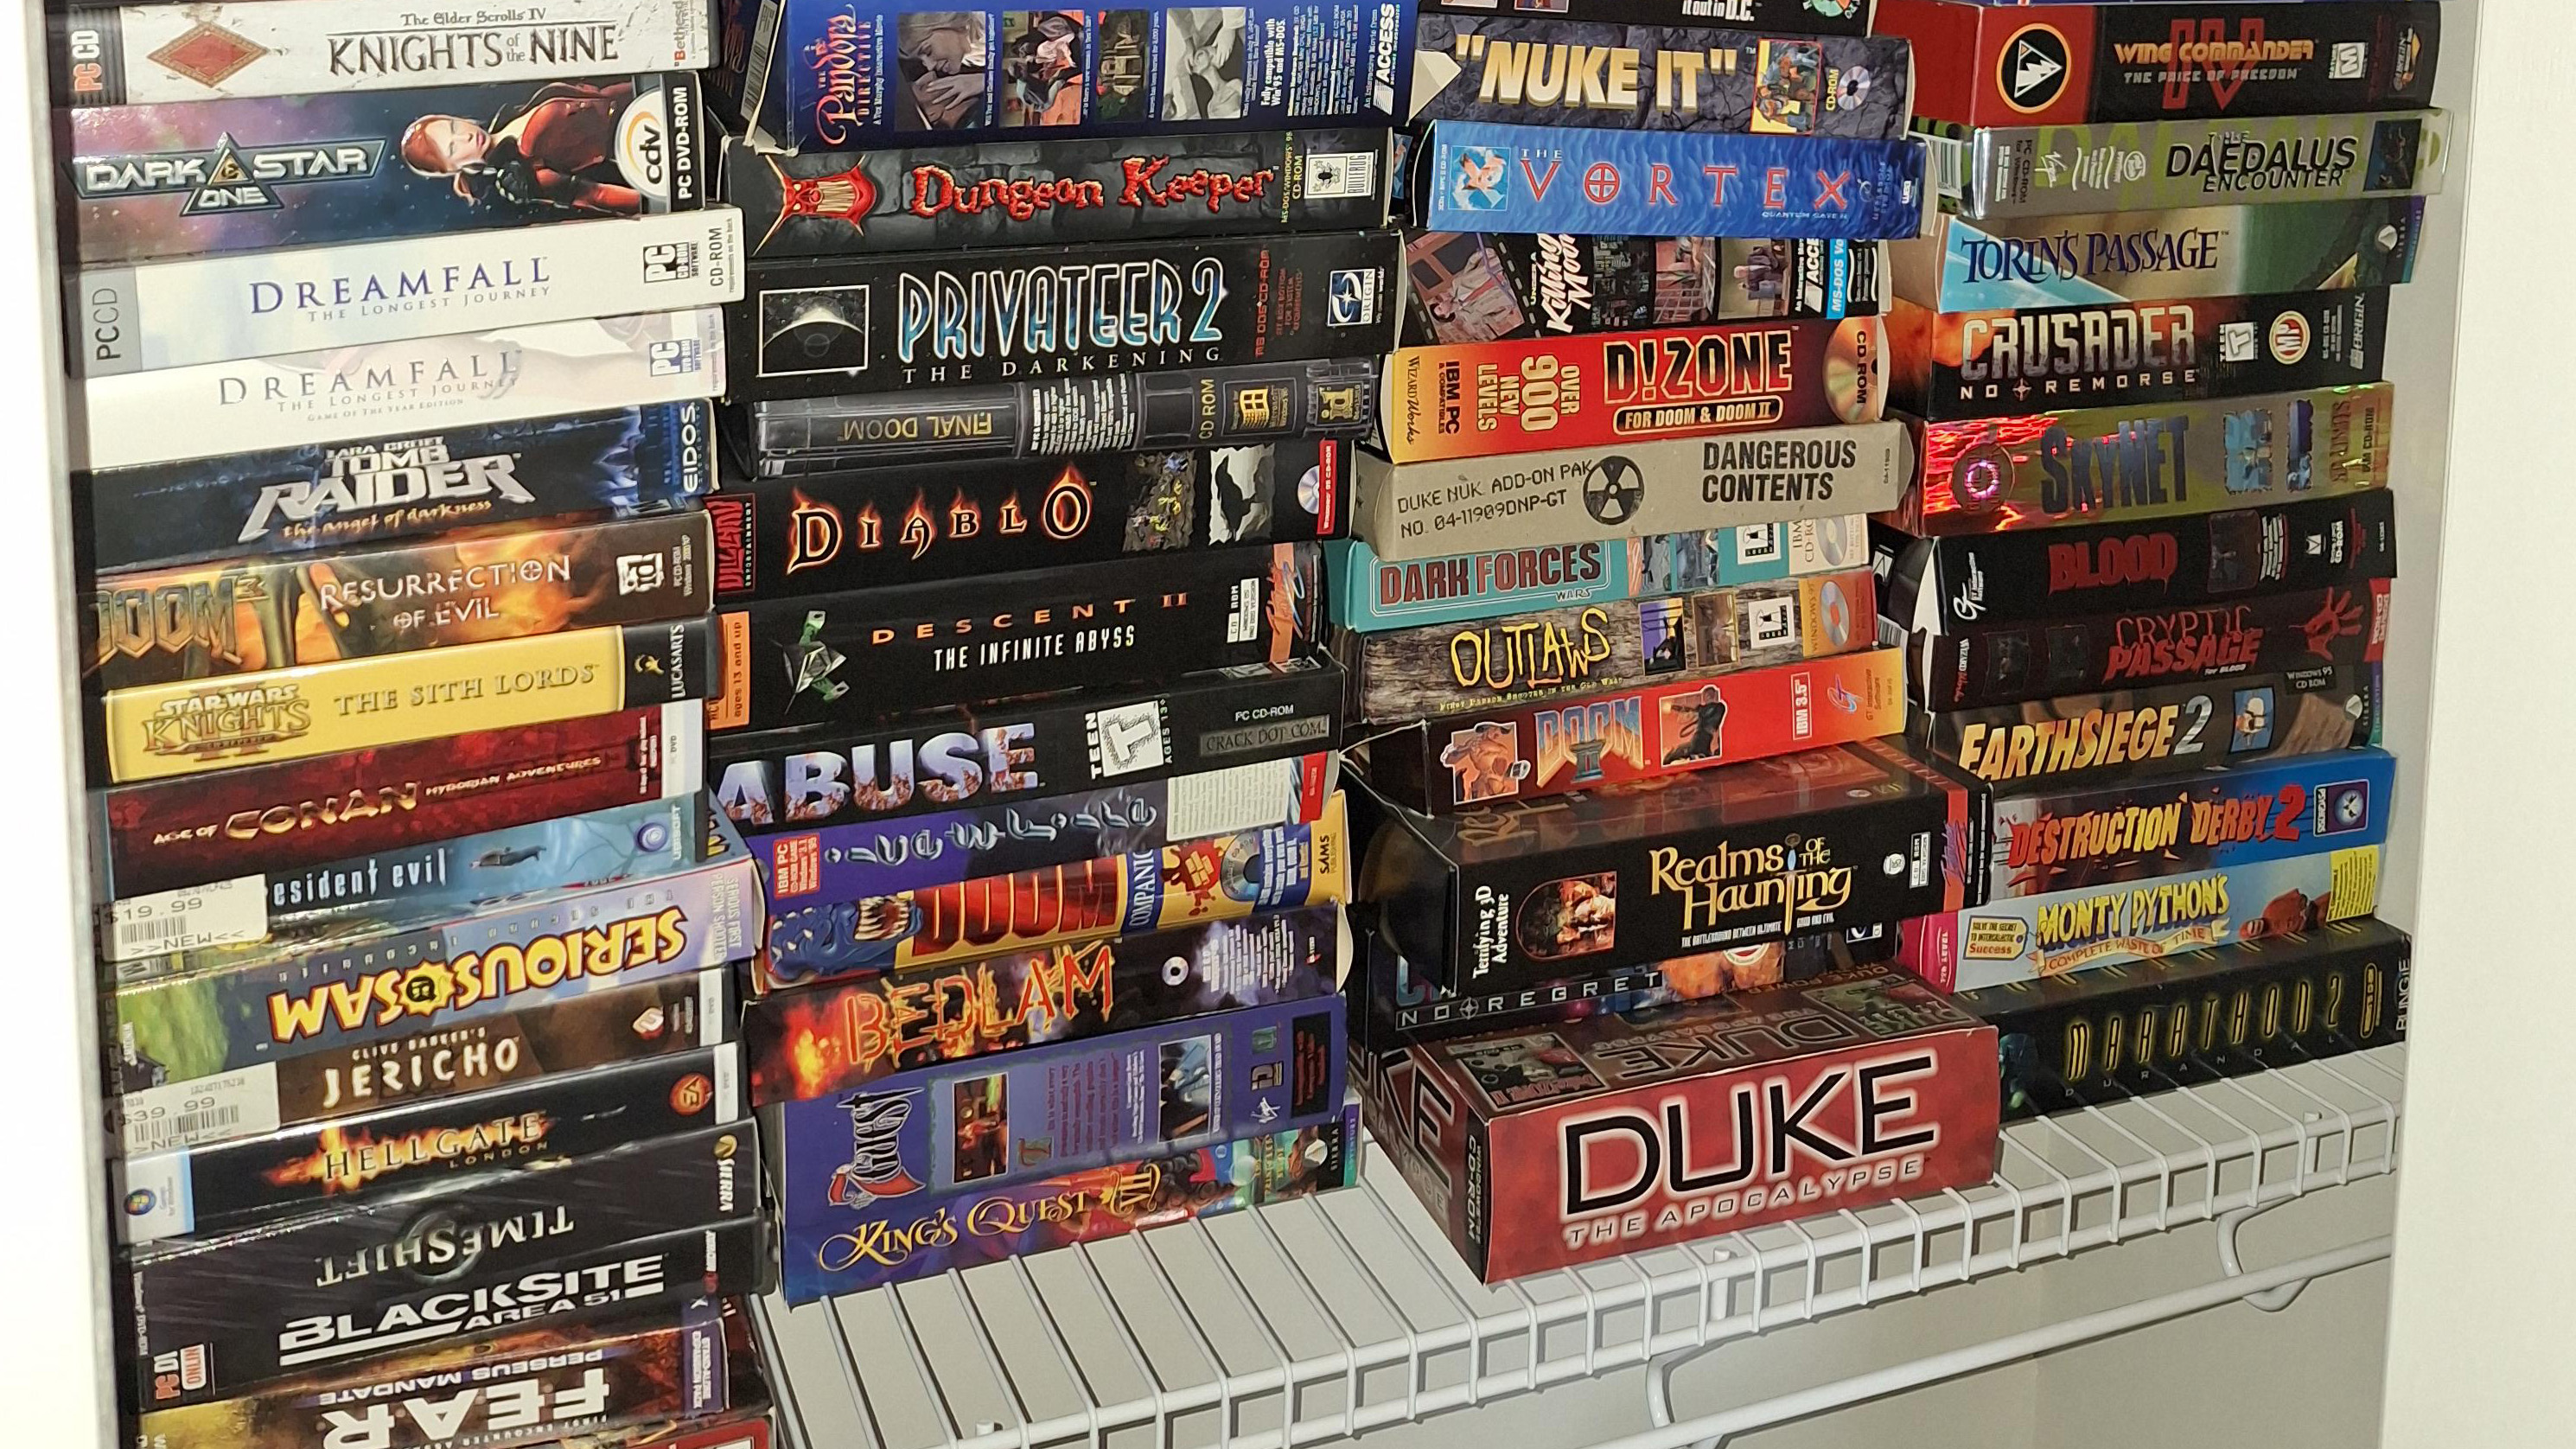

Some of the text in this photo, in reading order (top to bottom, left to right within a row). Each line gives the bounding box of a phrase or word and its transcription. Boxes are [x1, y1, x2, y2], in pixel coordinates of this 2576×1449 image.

[400, 7, 546, 27] The Elder Scrolls IV
[1376, 3, 1395, 84] ACCESS
[72, 31, 102, 92] PC CD
[327, 24, 620, 76] KNIGHTS of the NINE
[815, 3, 856, 146] Pandora
[858, 21, 873, 117] DIRECTIVE
[2114, 39, 2316, 66] WING COMMANDER
[2124, 67, 2299, 84] THE PRICE OF FREEDOM
[1825, 67, 1840, 112] CD-ROM
[85, 147, 369, 191] DARK STAR
[644, 125, 665, 187] cdv
[673, 86, 694, 200] PC DVD-ROM
[1521, 148, 1563, 161] THE
[2165, 136, 2358, 178] DAEDALUS
[197, 186, 269, 209] ONE
[910, 154, 1277, 222] Dungeon Keeper
[1291, 154, 1304, 201] CD-ROM
[1520, 159, 1852, 211] VORTEX
[2202, 168, 2344, 194] ENCOUNTER
[710, 227, 724, 287] CD-ROM
[1960, 227, 2220, 285] TORIN'S PASSAGE
[249, 257, 551, 315] DREAMFALL
[309, 285, 552, 323] THE LONGEST JOURNEY
[896, 256, 1225, 365] PRIVATEER 2
[1362, 270, 1374, 323] ORIGIN
[902, 346, 1221, 386] THE DARKENING
[1603, 329, 1793, 405] D!ZONE
[1853, 329, 1867, 405] CD ROM
[1961, 304, 2196, 381] CRUSADER
[219, 350, 519, 406] DREAMFALL
[277, 375, 519, 413] THE LONGEST JOURNEY
[1445, 361, 1461, 435] IBM PC
[1476, 362, 1499, 432] LEVELS
[1499, 374, 1520, 417] NEW
[1520, 354, 1559, 432] 900
[1559, 364, 1581, 415] OVER
[1960, 370, 2197, 401] NO REMORSE
[844, 412, 992, 442] FINAL DOOM
[1199, 379, 1216, 440] CD ROM
[1623, 400, 1772, 428] FOR DOOM & DOOM II
[324, 447, 450, 477] TOMB
[680, 404, 699, 494] EIDOS
[1702, 439, 1858, 472] DANGEROUS
[2040, 414, 2190, 515] SKYNET
[238, 453, 537, 544] RAIDER
[1400, 489, 1568, 540] NO. 04-11909DNP-GT
[1701, 472, 1834, 505] CONTENTS
[786, 481, 1093, 576] DIABLO
[321, 555, 571, 610] RESURRECTION
[1379, 541, 1604, 608] DARK FORCES
[2048, 533, 2178, 595] BLOOD
[392, 597, 500, 630] OF EVIL
[872, 591, 1189, 646] DESCENT II
[1554, 586, 1595, 602] WARS
[933, 626, 1137, 673] THE INFINITE ABYSS
[1451, 605, 1610, 690] OUTLAWS
[2101, 628, 2264, 685] PASSAGE
[2114, 607, 2253, 649] CRYPTIC
[671, 624, 685, 698] LUCASARTS
[732, 621, 743, 718] ages 13 and up
[335, 664, 595, 718] THE SITH LORDS
[1234, 704, 1294, 722] PC CD-ROM
[1794, 679, 1808, 735] IBM 3.5"
[143, 699, 311, 753] KNIGHTS
[1085, 712, 1103, 779] TEEN
[1959, 694, 2217, 782] EARTHSIEGE 2
[717, 722, 1039, 825] ABUSE
[671, 803, 682, 861] UBISOFT
[2007, 803, 2182, 871] DESTRUCTION
[2191, 792, 2275, 848] DERBY
[2272, 783, 2308, 842] 2
[2314, 786, 2328, 835] PSYGNOSIS
[776, 843, 788, 894] IBM PC
[1319, 834, 1331, 875] SAMS
[726, 877, 743, 948] SERIOUS FIRST
[1648, 836, 1854, 936] Realms OF THE Haunting
[2037, 873, 2230, 948] MONTY PYTHON'S
[1491, 893, 1510, 965] Adventure
[1969, 942, 2012, 955] Success
[267, 905, 689, 1044] SERIOUS SAM
[844, 939, 1116, 1066] BEDLAM
[1400, 973, 1660, 1026] NO REGRET
[322, 1037, 520, 1109] JERICHO
[323, 1113, 545, 1181] HELLGATE
[450, 1139, 551, 1170] LONDON
[1563, 1053, 1935, 1216] DUKE
[716, 1156, 736, 1212] SIERRA
[1565, 1159, 1922, 1248] THE APOCALYPSE
[316, 1204, 574, 1288] TIMESHIFT
[817, 1164, 1162, 1273] KING'S QUEST VII
[280, 1254, 666, 1351] BLACKSITE
[464, 1287, 622, 1331] AREA 51
[319, 1349, 603, 1407] PERSEUS MANDATE
